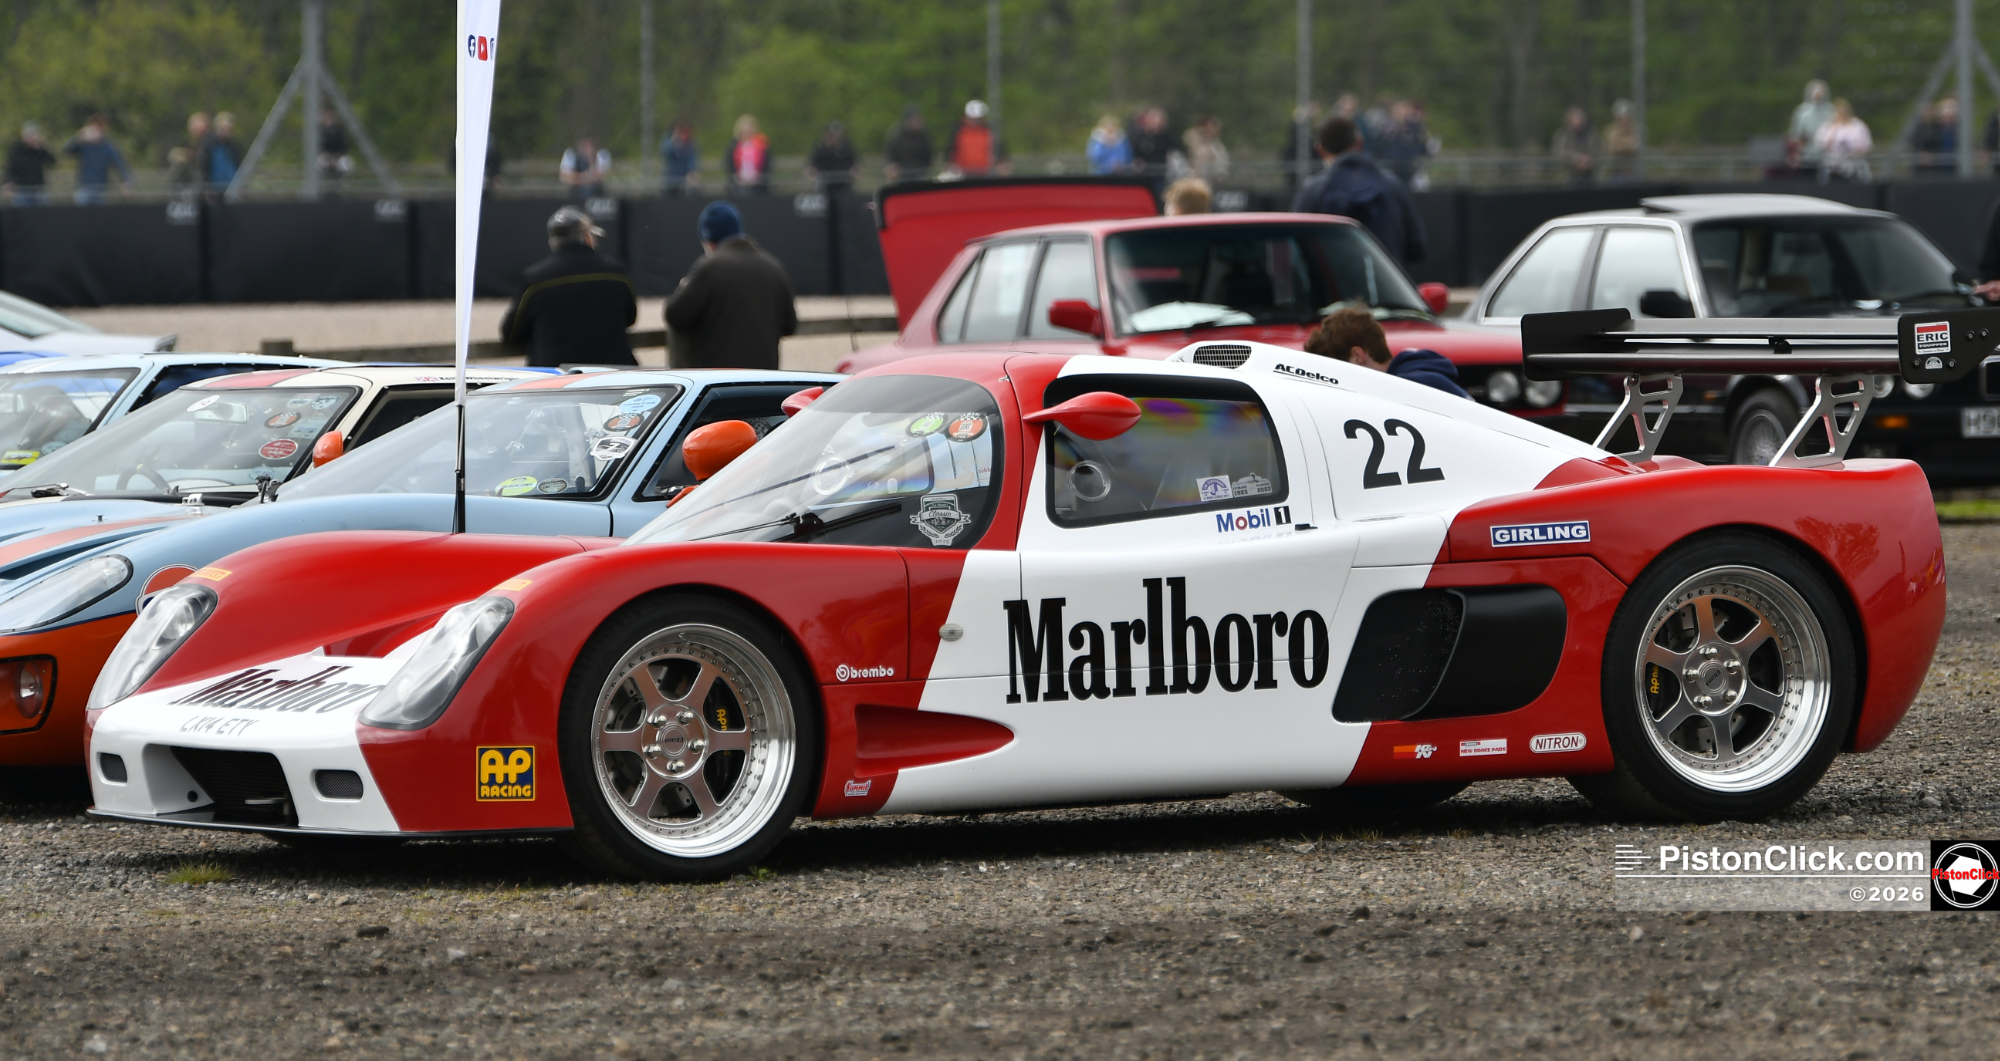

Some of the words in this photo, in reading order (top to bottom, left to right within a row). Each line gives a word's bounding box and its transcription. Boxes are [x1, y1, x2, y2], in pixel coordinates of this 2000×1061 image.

[1917, 332, 1949, 342] ERIC
[1274, 363, 1339, 385] ACDelco
[1344, 419, 1446, 490] 22
[928, 510, 952, 518] Classic
[1216, 508, 1271, 533] Mobil
[1495, 525, 1588, 543] GIRLING
[1003, 577, 1330, 704] Marlboro
[850, 665, 894, 679] brembo
[167, 665, 386, 714] Marlboro
[216, 717, 259, 737] ETY
[481, 749, 531, 784] AP
[481, 785, 531, 797] RACING
